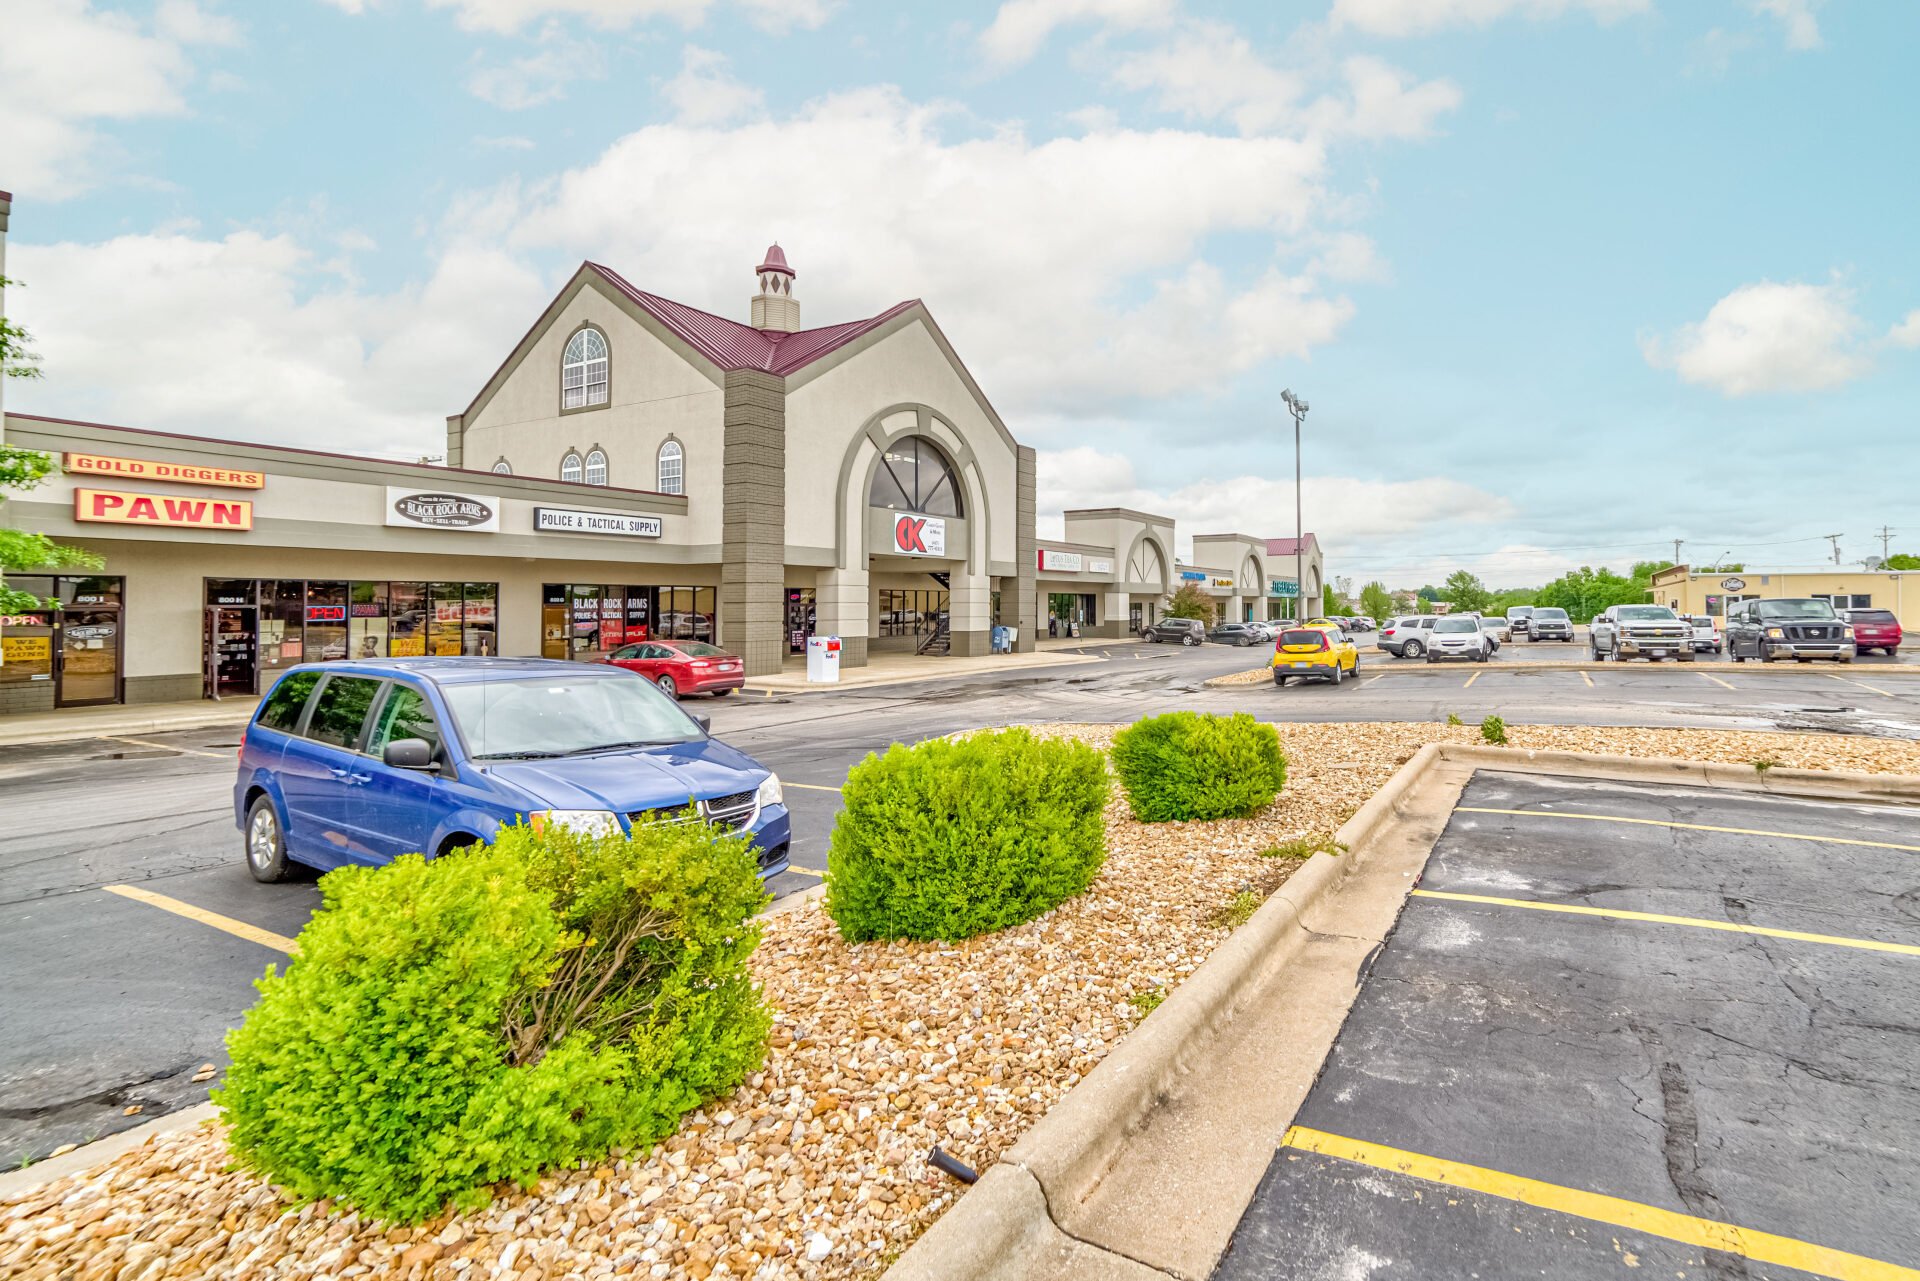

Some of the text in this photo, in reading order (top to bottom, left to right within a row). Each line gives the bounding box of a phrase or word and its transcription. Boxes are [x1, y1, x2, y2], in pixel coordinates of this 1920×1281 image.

[77, 457, 258, 484] GOLD DIGGERS
[92, 493, 242, 525] PAWN
[407, 502, 481, 517] BLACK ROCK ARMS
[541, 513, 658, 533] POLICE & TACTICAL SUPPLY
[895, 516, 928, 553] CK
[574, 598, 648, 609] BLACK ROCK ARMS
[574, 611, 591, 620] POLICE
[602, 611, 623, 619] TACTICAL
[629, 611, 646, 619] SUPPLY
